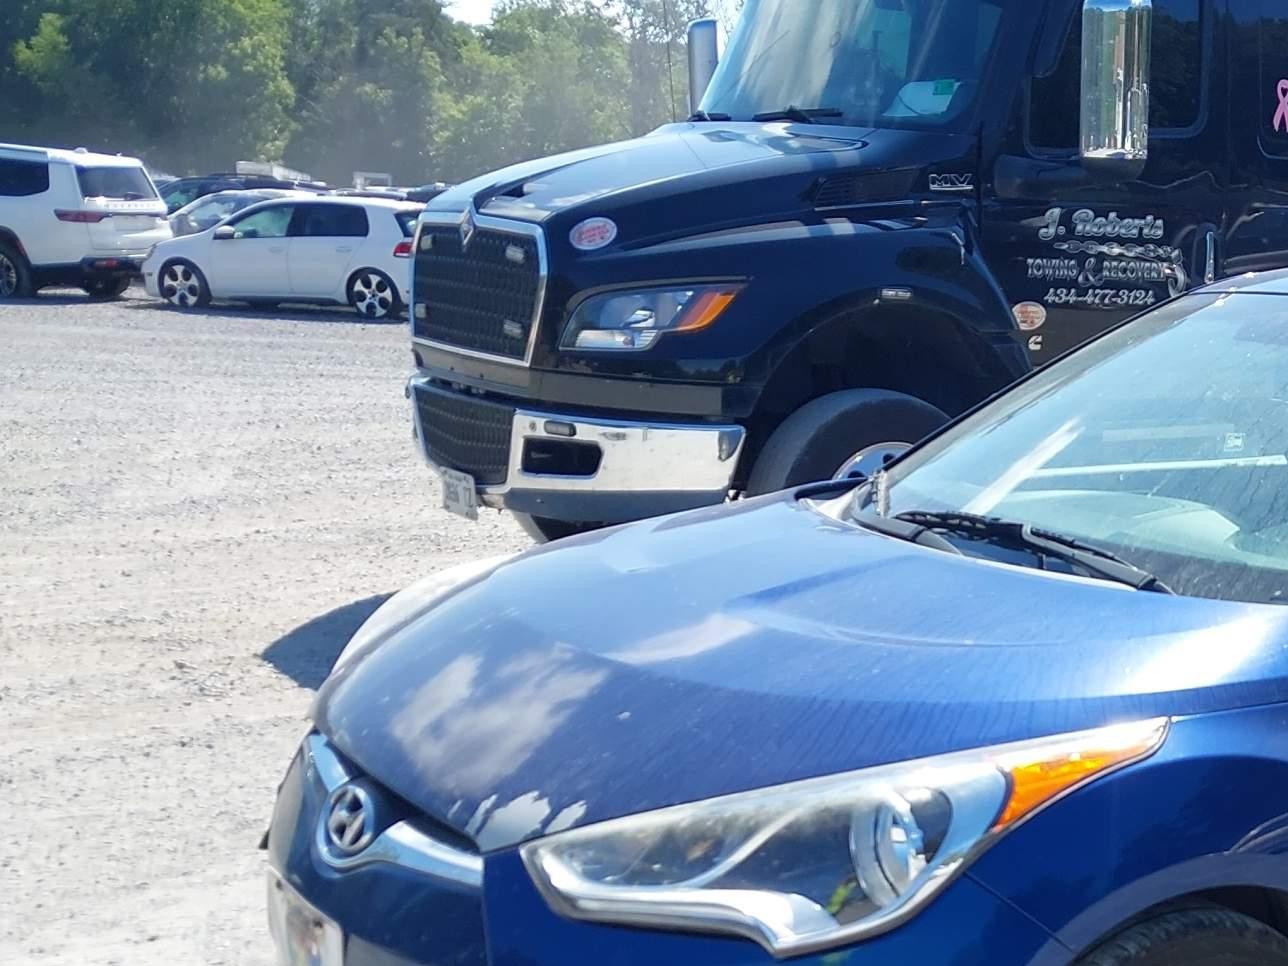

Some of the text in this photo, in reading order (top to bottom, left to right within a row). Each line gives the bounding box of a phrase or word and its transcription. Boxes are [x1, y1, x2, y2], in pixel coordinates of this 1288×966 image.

[928, 172, 974, 188] MV
[1072, 208, 1164, 239] Roberts
[1026, 257, 1171, 287] TOWING & RECOVERY
[1044, 288, 1157, 305] 434-477-3124
